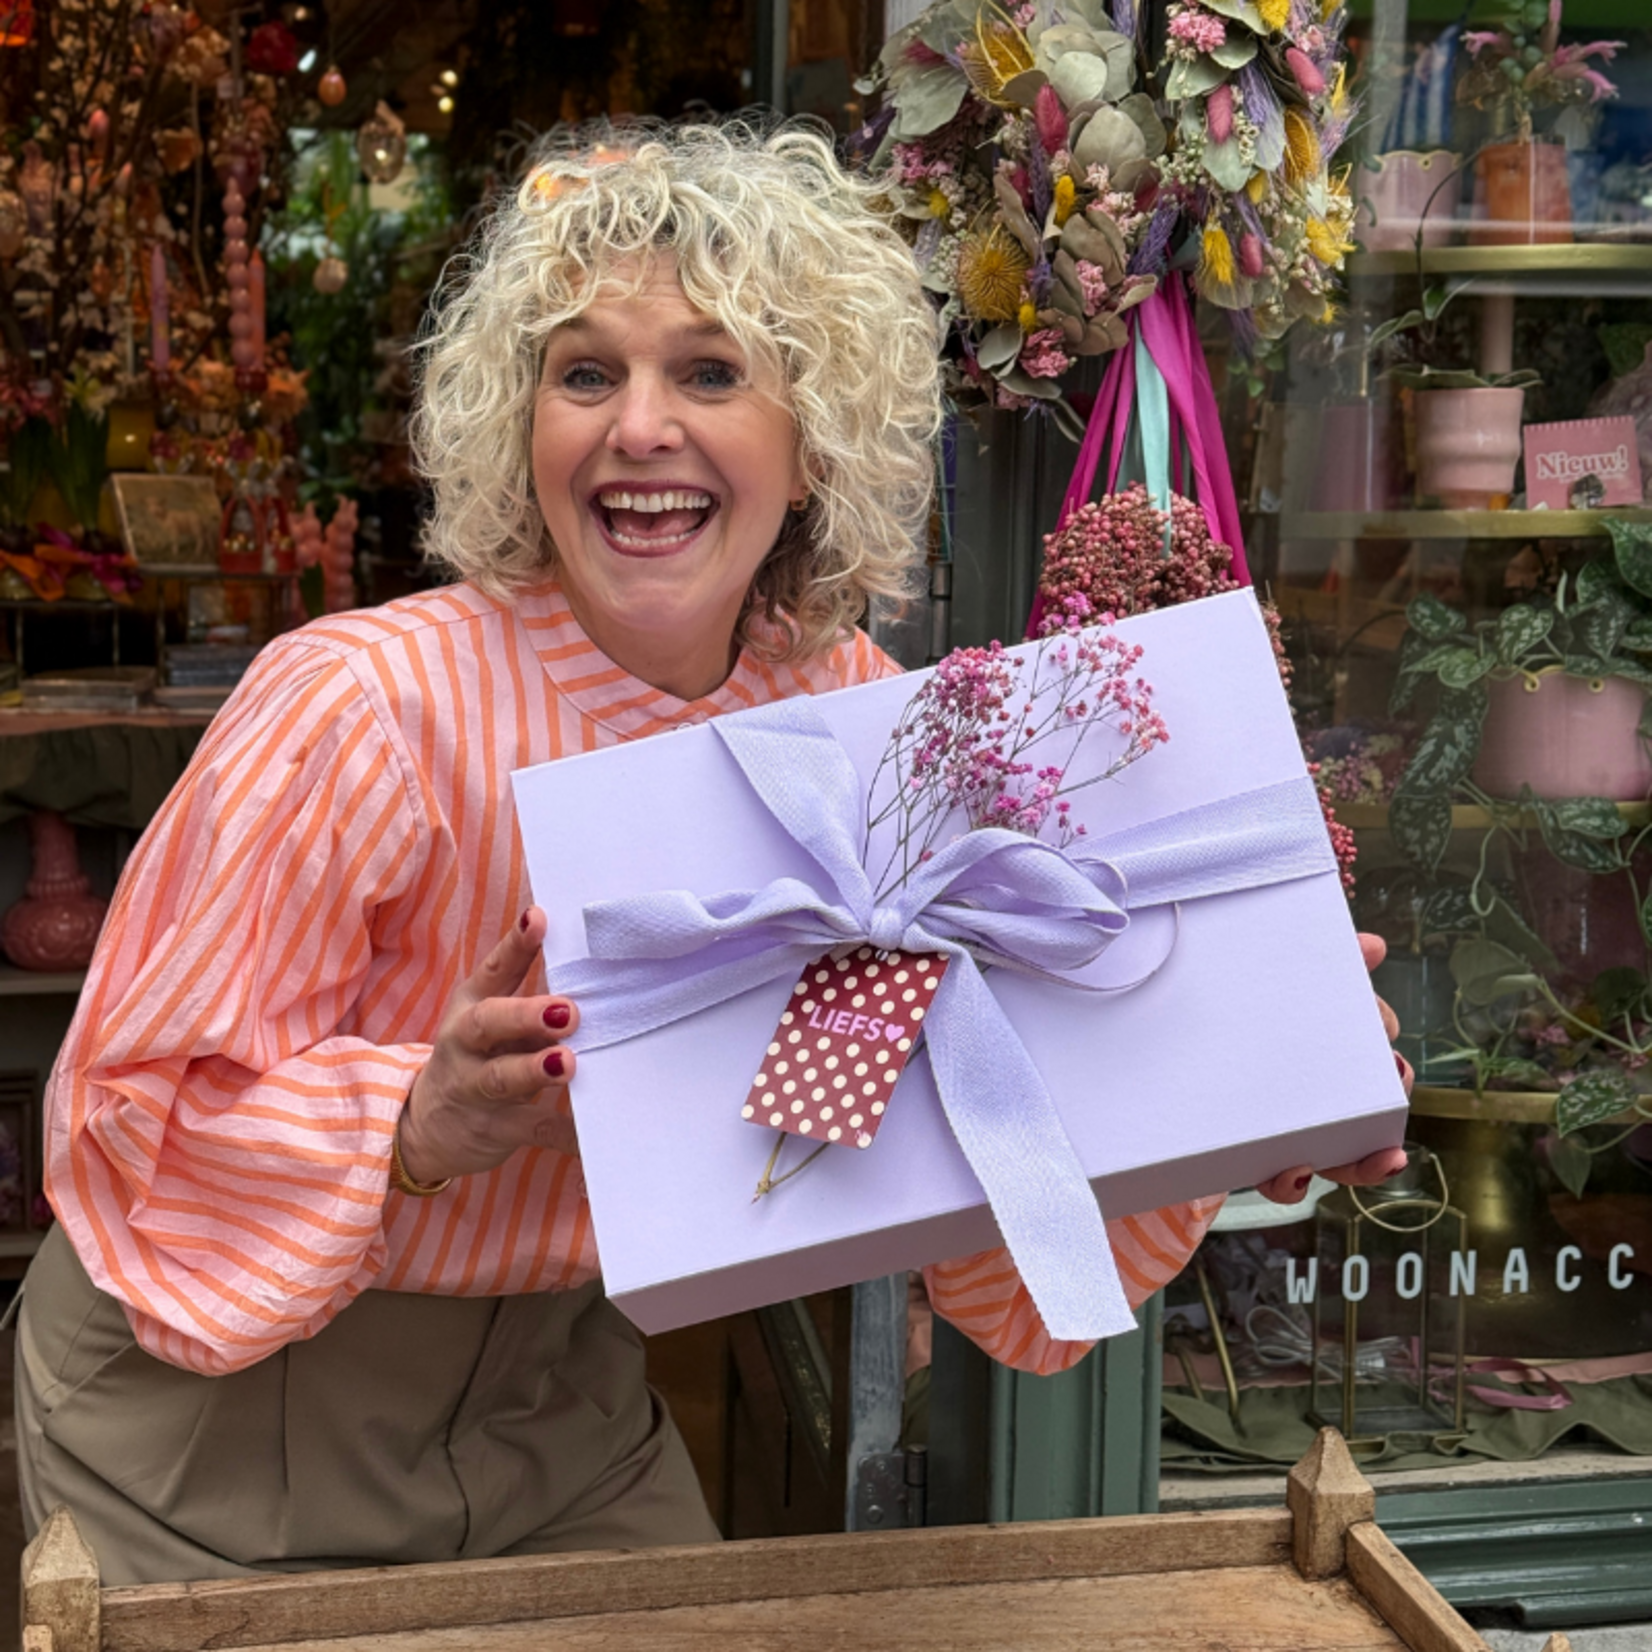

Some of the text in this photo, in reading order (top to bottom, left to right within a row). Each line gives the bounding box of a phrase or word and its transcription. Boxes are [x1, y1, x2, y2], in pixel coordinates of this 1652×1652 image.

[1537, 445, 1628, 479] Nieuw!
[808, 1005, 885, 1042] LIEFS
[1286, 1243, 1635, 1304] WOONACC
